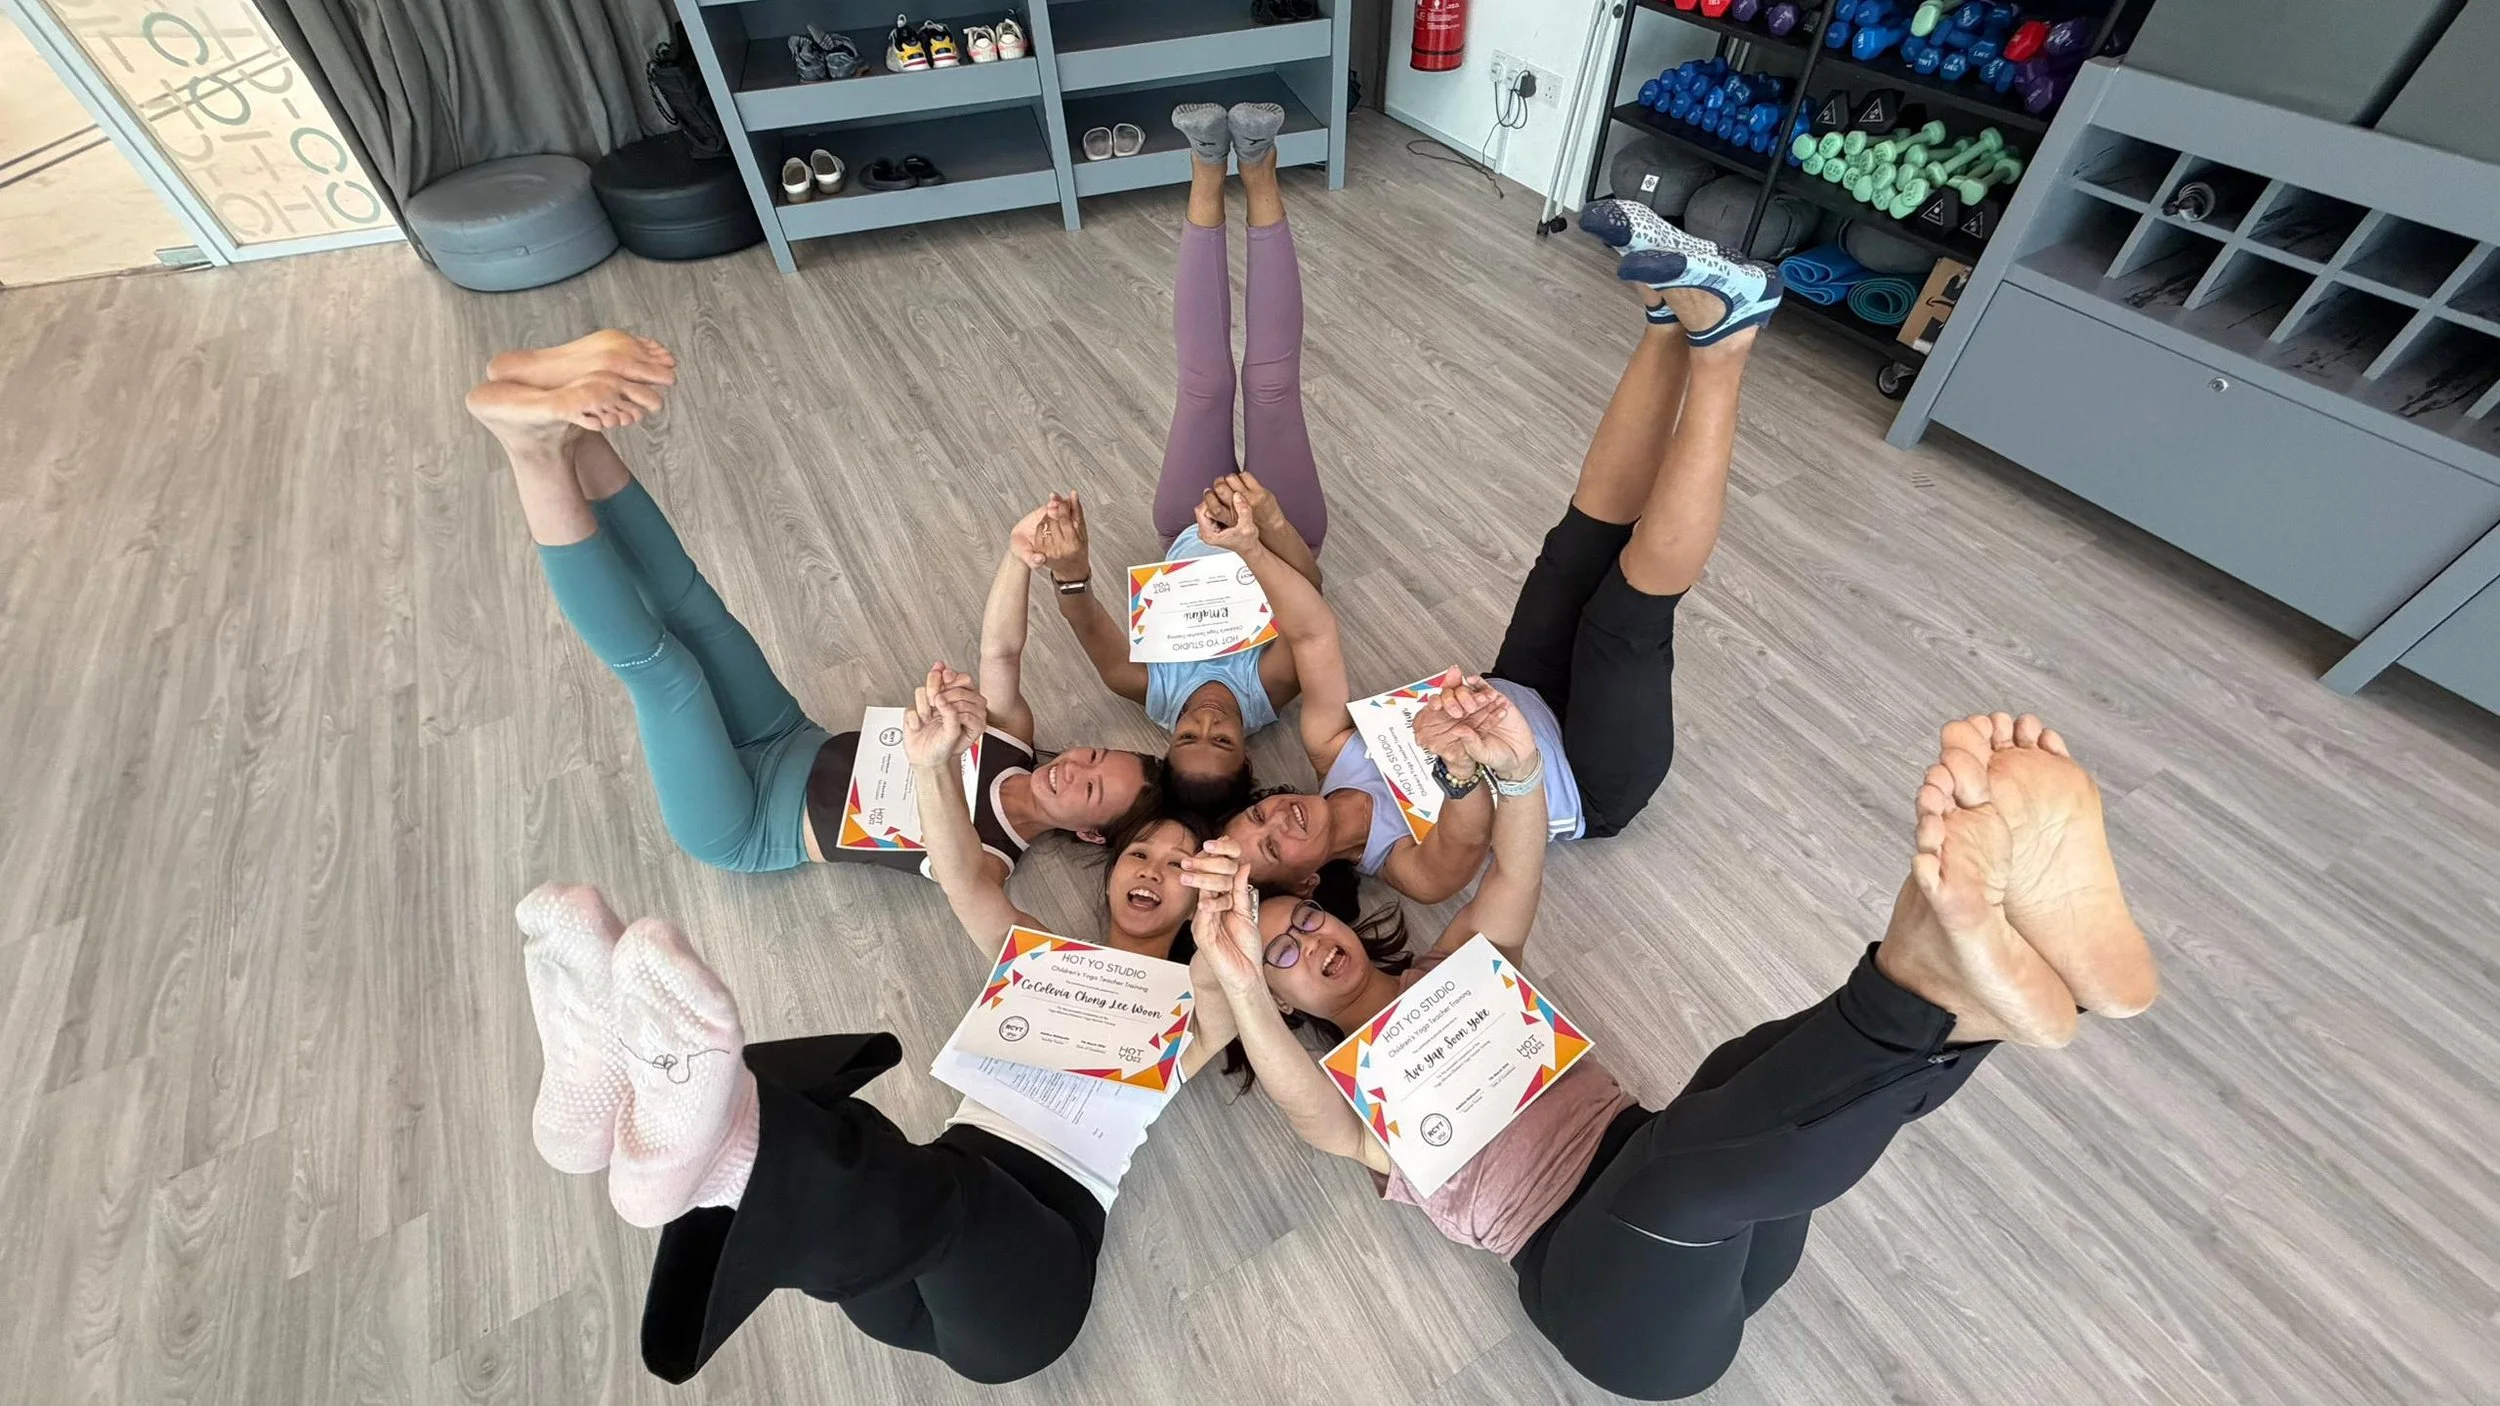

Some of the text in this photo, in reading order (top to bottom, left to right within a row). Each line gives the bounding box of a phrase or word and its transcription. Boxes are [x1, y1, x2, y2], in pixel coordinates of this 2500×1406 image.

[1172, 635, 1239, 651] HOT YO STUDIO
[1377, 734, 1415, 795] HOT YO STUDIO
[1051, 964, 1080, 977] Children's
[1082, 972, 1098, 981] Yoga
[1099, 975, 1124, 986] Teacher
[1124, 982, 1148, 993] Training
[1062, 953, 1147, 980] HOT YO STUDIO
[1074, 990, 1107, 1009] Chong
[1108, 999, 1129, 1011] Lee
[1131, 1003, 1163, 1019] Woon
[1382, 1021, 1405, 1043] HOT
[1402, 1009, 1420, 1024] YO
[1420, 980, 1455, 1012] STUDIO
[1005, 1024, 1023, 1033] RCYT
[1388, 1033, 1415, 1058] Children's
[1414, 1022, 1430, 1036] Yoga
[1428, 1006, 1450, 1023] Teacher
[1448, 989, 1472, 1008] Training
[1444, 1027, 1469, 1049] Soon
[1466, 1008, 1490, 1032] Yoke
[1119, 1046, 1144, 1056] HOT
[1516, 1034, 1538, 1056] HOT
[1427, 1121, 1444, 1138] RCYT
